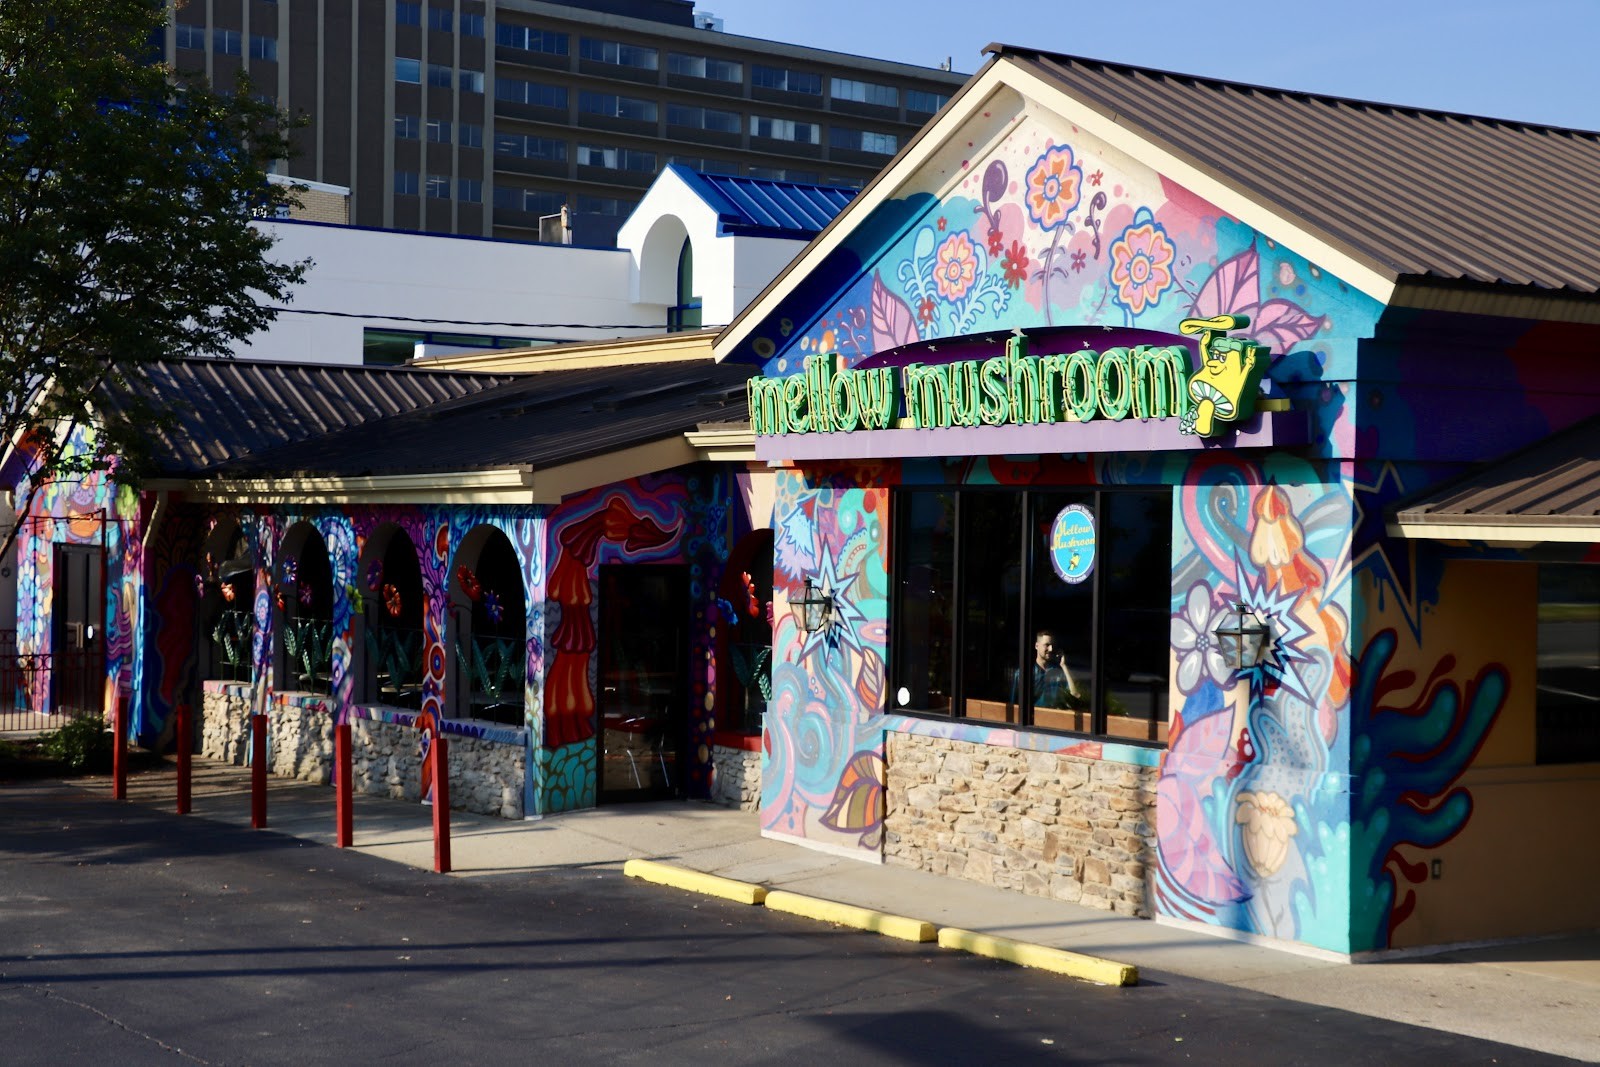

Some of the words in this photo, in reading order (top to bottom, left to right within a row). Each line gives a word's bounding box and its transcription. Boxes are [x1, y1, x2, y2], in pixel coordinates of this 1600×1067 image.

[747, 353, 897, 436] mellow
[903, 336, 1192, 430] mushroom
[1059, 520, 1091, 537] Mellow
